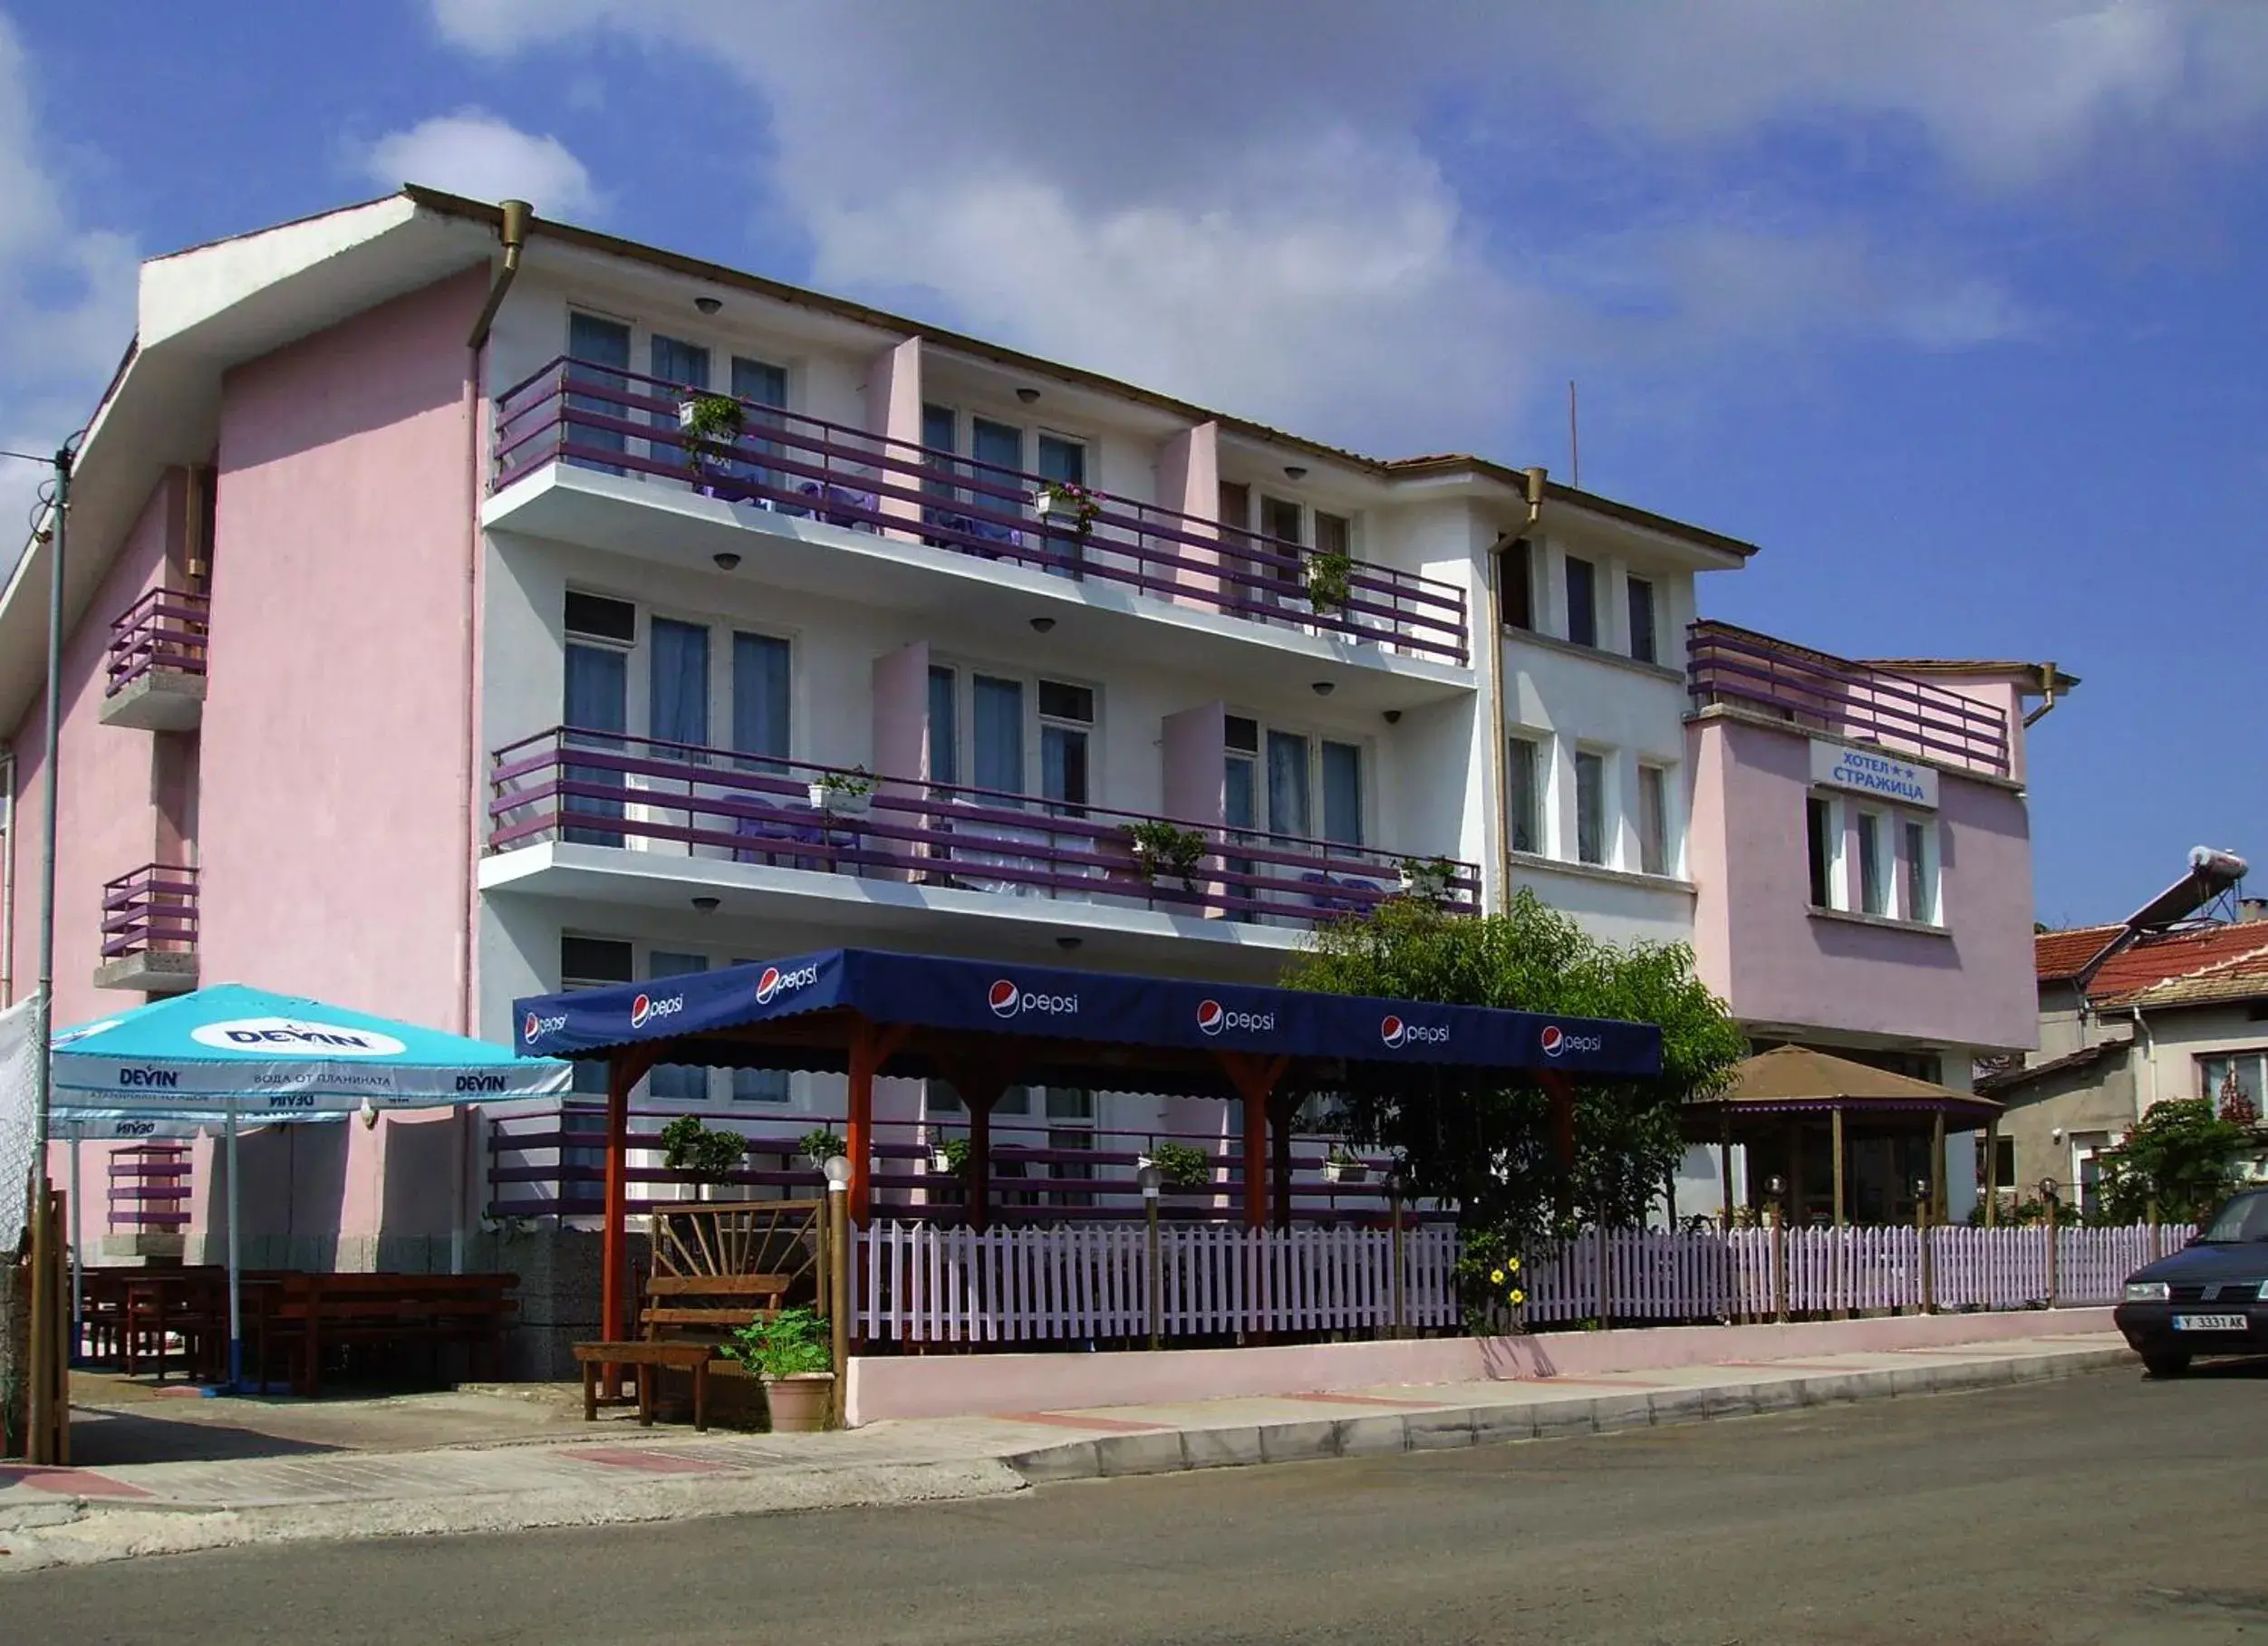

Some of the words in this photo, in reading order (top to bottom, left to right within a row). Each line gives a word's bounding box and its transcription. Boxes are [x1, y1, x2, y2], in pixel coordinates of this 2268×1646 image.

[1843, 752, 1889, 775] ХОТЕЛ
[1833, 766, 1925, 800] СТРАЖИЦА
[776, 962, 817, 995] pepsi
[649, 993, 683, 1020] pepsi
[1022, 993, 1078, 1015] pepsi
[539, 1014, 568, 1035] pepsi
[1225, 1012, 1274, 1033] pepsi
[226, 1025, 371, 1048] DEVIN
[1406, 1025, 1450, 1044] pepsi
[1565, 1034, 1602, 1053] pepsi
[119, 1065, 178, 1087] DEVIN
[255, 1073, 291, 1083] ВОДА
[295, 1073, 312, 1083] ОТ
[317, 1073, 391, 1086] ПЛАНИНАТА
[456, 1071, 505, 1092] DEVIN
